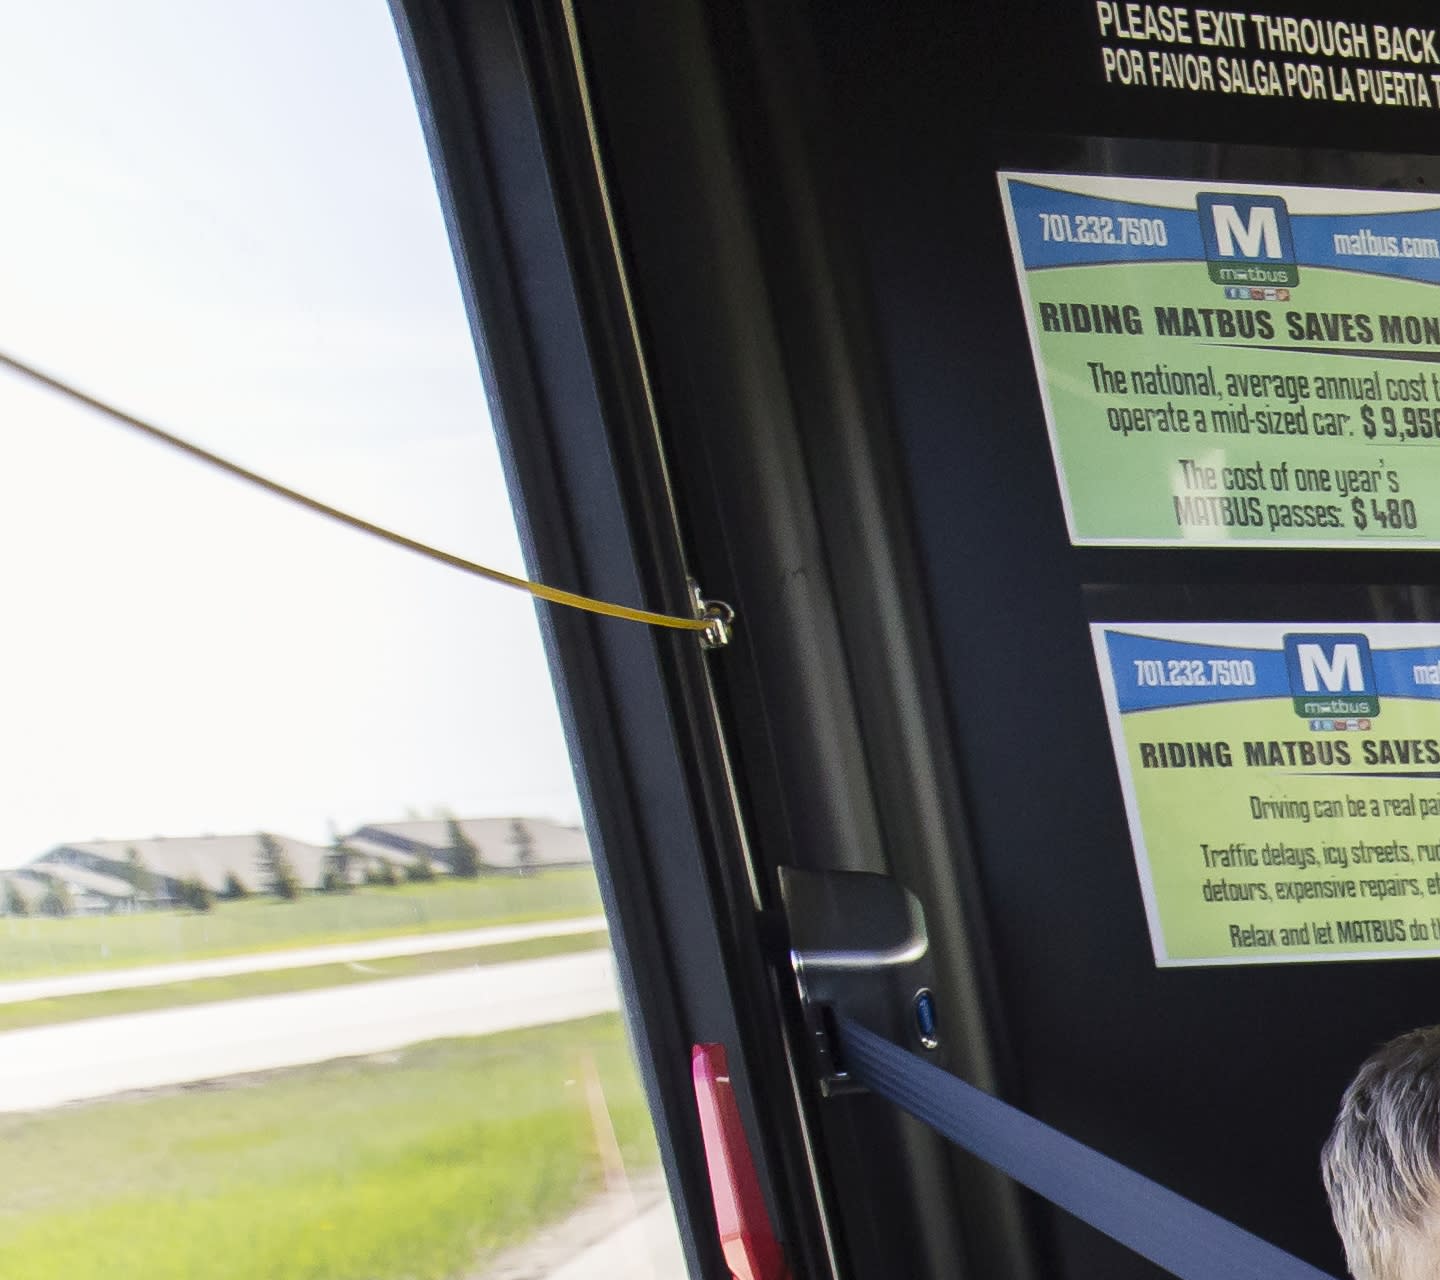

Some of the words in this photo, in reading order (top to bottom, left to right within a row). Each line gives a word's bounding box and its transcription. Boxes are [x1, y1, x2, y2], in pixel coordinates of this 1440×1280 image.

[1096, 1, 1192, 44] PLEASE
[1195, 9, 1245, 48] EXIT
[1251, 14, 1370, 58] THROUGH
[1374, 25, 1440, 64] BACK
[1102, 47, 1147, 85] POR
[1148, 51, 1215, 92] FAVOR
[1216, 57, 1284, 96] SALGA
[1284, 62, 1326, 99] POR
[1329, 66, 1356, 102] LA
[1356, 68, 1432, 108] PUERTA
[1039, 213, 1168, 246] 701.232.7500
[1212, 205, 1283, 258] M
[1333, 229, 1440, 259] matbus.com
[1039, 302, 1143, 335] RIDING
[1154, 306, 1275, 339] MATBUS
[1286, 311, 1373, 343] SAVES
[1087, 362, 1127, 394] The
[1130, 364, 1224, 401] national,
[1225, 372, 1310, 404] average
[1314, 371, 1382, 400] annual
[1386, 372, 1429, 401] cost
[1107, 402, 1189, 436] operate
[1193, 410, 1207, 433] a
[1211, 403, 1308, 435] mid-sized
[1178, 459, 1217, 490] The
[1222, 460, 1267, 491] cost
[1270, 461, 1289, 491] of
[1295, 468, 1332, 492] one
[1335, 458, 1400, 498] year's
[1173, 496, 1264, 527] MATBUS
[1134, 660, 1256, 687] 701.232.7500
[1297, 643, 1365, 692] M
[1139, 741, 1233, 769] RIDING
[1243, 740, 1350, 767] MATBUS
[1361, 739, 1440, 765] SAVES
[1249, 794, 1310, 823] Driving
[1313, 800, 1344, 818] can
[1346, 794, 1367, 818] be
[1370, 799, 1380, 817] a
[1383, 793, 1416, 817] real
[1200, 843, 1258, 868] Traffic
[1262, 842, 1321, 870] delays,
[1322, 841, 1348, 869] icy
[1352, 840, 1415, 865] streets,
[1202, 878, 1273, 902] detours,
[1275, 875, 1356, 903] expensive
[1360, 873, 1424, 900] repairs,
[1229, 924, 1275, 948] Relax
[1279, 922, 1310, 946] and
[1312, 922, 1334, 945] let
[1336, 919, 1406, 943] MATBUS
[1409, 918, 1428, 941] do
